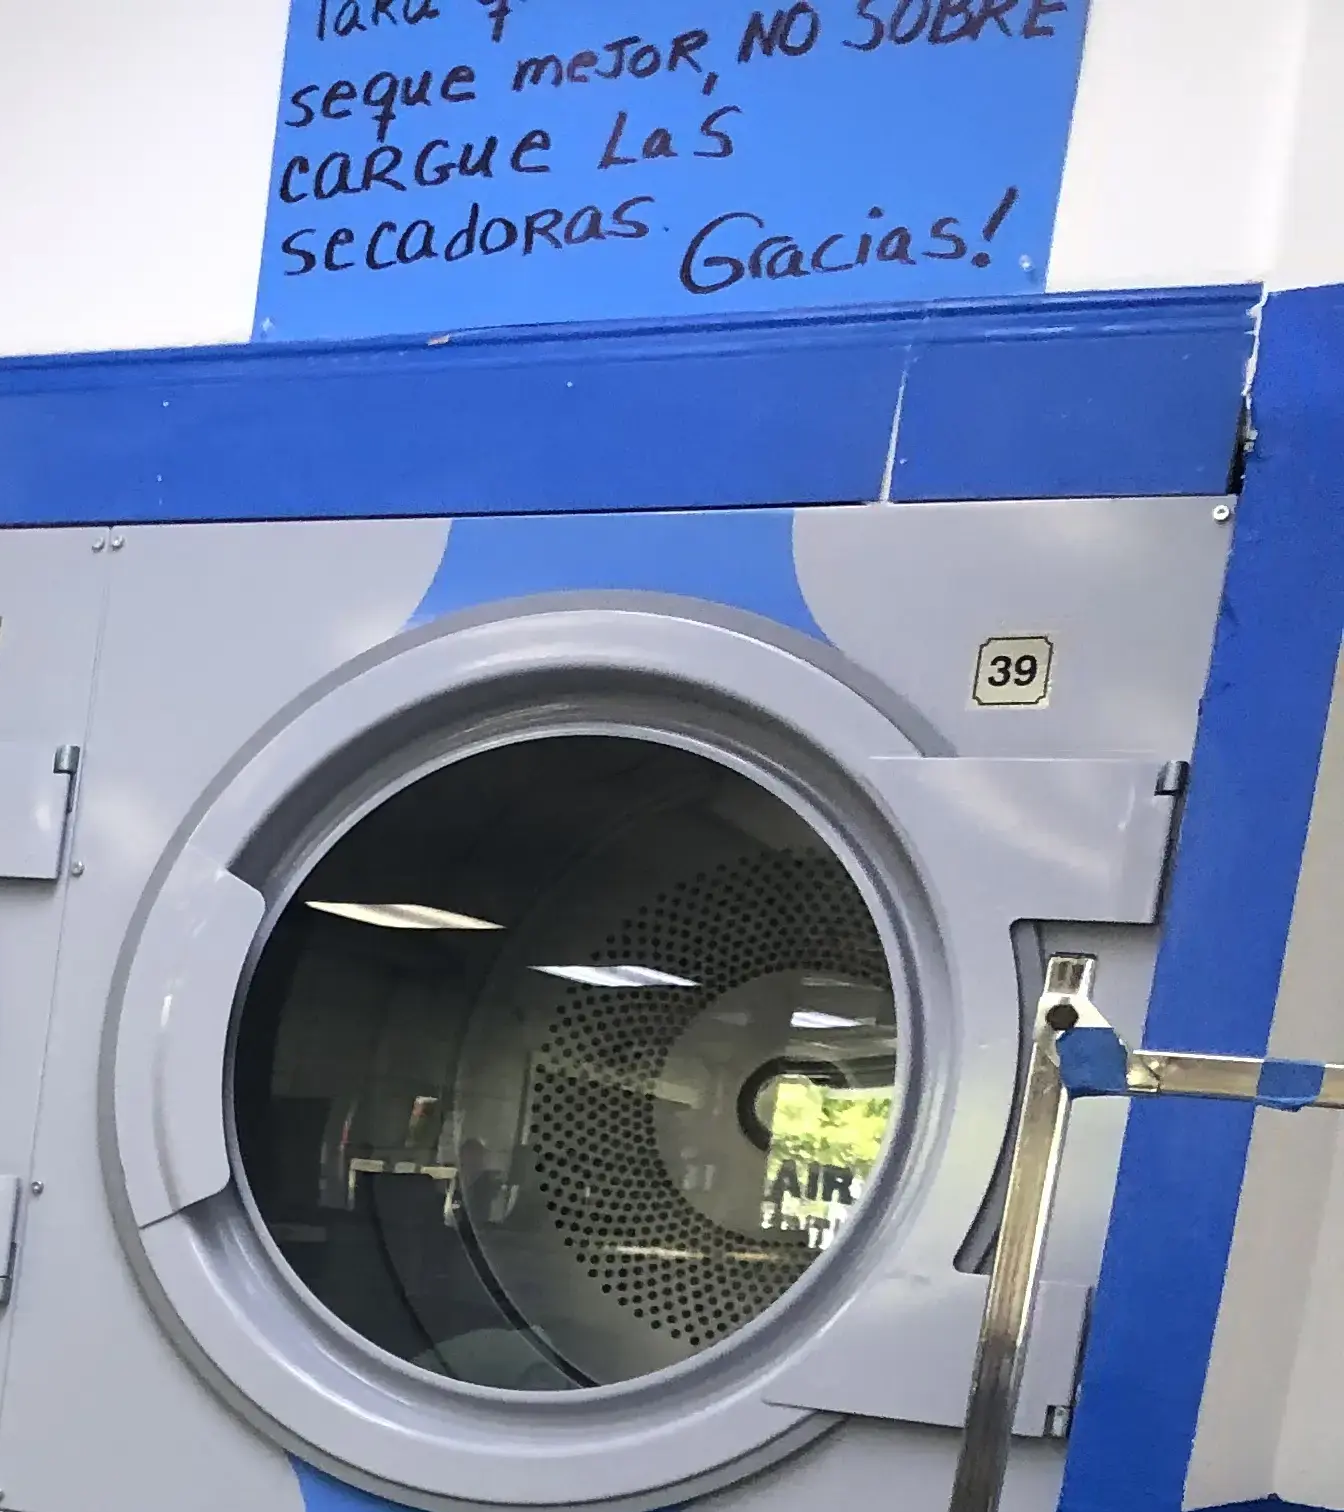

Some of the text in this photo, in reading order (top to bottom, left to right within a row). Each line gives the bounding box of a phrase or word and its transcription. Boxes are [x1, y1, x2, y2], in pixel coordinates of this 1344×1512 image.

[283, 65, 476, 142] seque
[737, 2, 820, 64] NO
[842, 0, 1067, 51] SOBRE
[678, 184, 1019, 295] Gracias!
[987, 654, 1037, 687] 39
